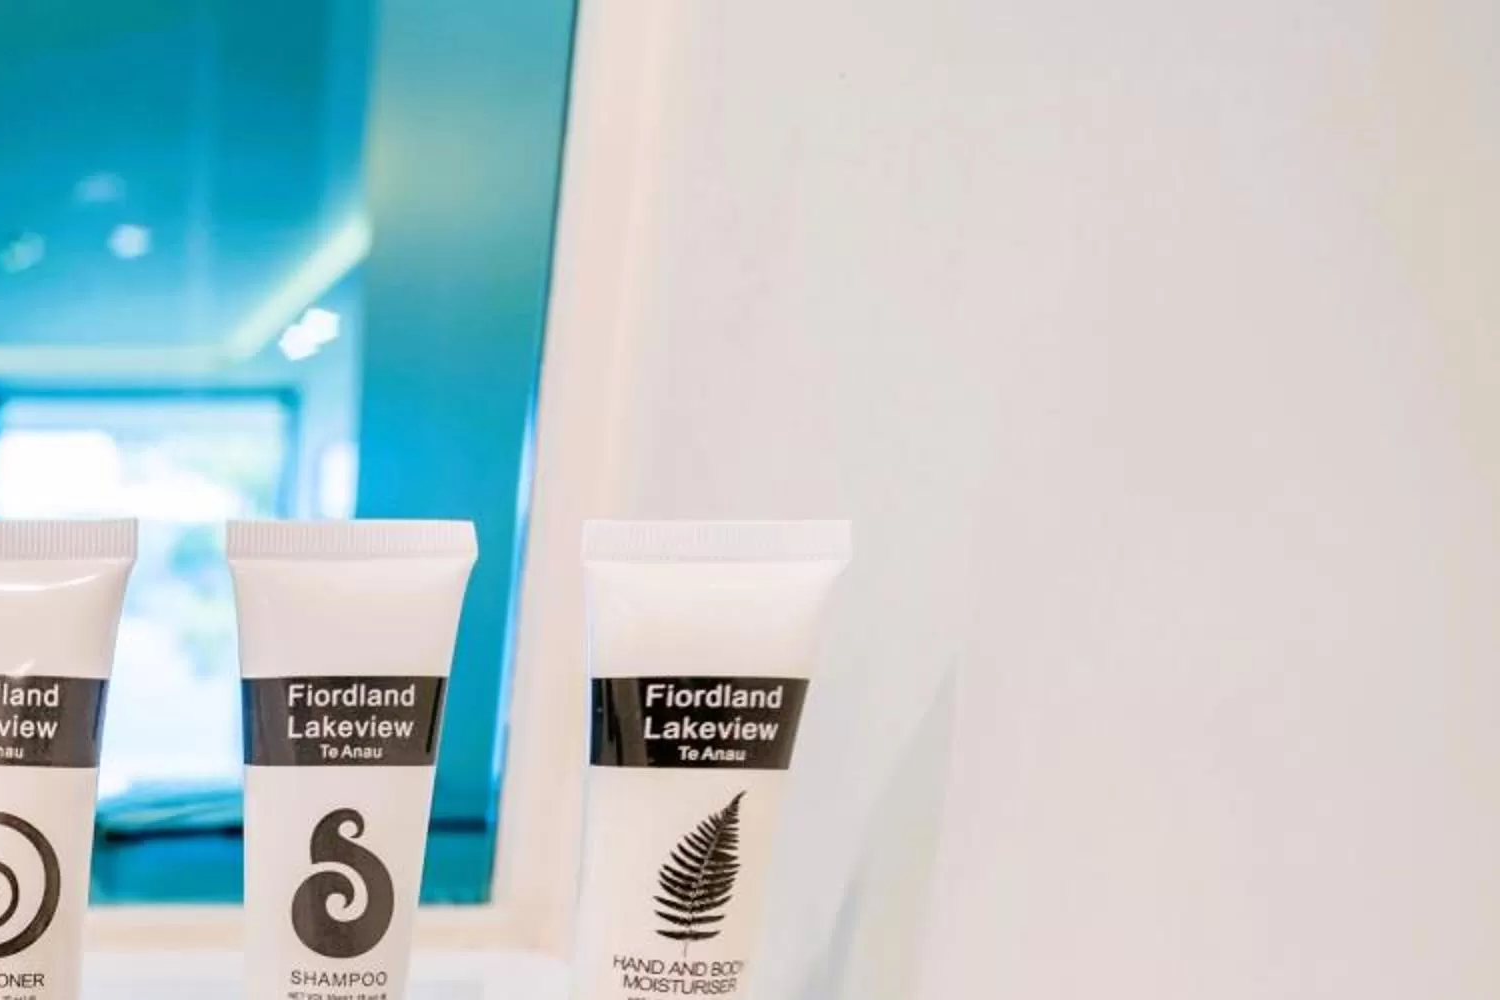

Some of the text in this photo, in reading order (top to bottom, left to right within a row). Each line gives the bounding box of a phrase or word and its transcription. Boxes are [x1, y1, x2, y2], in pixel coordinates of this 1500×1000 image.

[288, 684, 416, 707] Fiordland
[645, 684, 784, 709] Fiordland
[287, 716, 414, 739] Lakeview
[643, 716, 779, 741] Lakeview
[319, 744, 383, 759] Te Anau
[678, 745, 747, 761] Te Anau
[612, 954, 665, 975] HAND
[668, 961, 707, 977] AND
[290, 969, 388, 988] SHAMPOO
[622, 975, 738, 995] MOISTURISER
